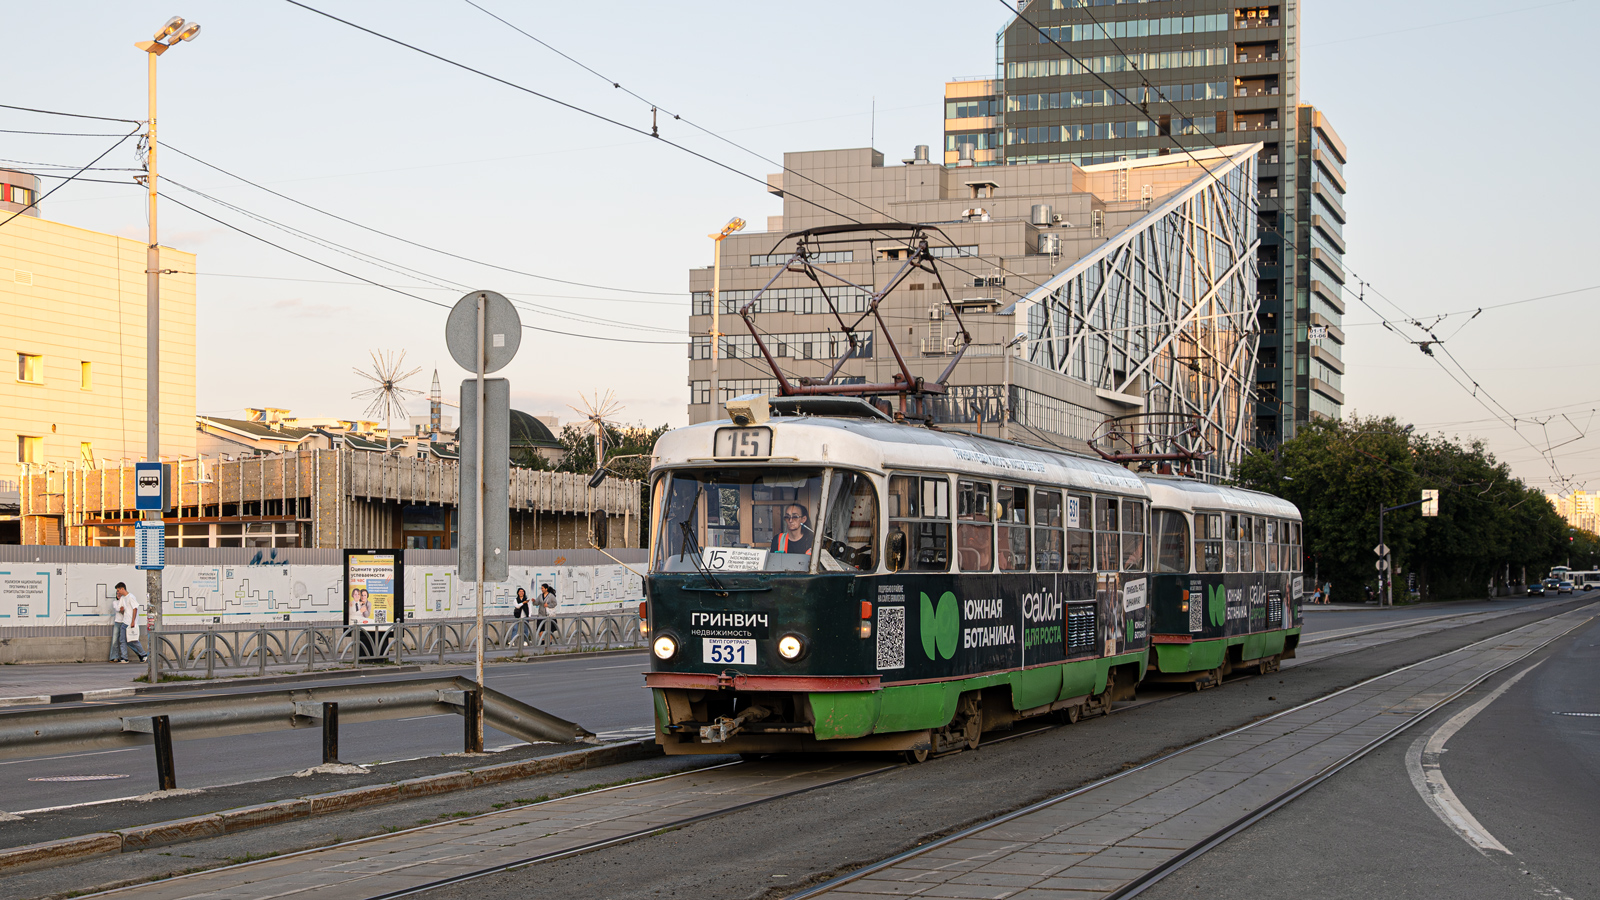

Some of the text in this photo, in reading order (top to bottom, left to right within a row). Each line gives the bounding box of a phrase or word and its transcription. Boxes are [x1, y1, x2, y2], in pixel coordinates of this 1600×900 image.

[728, 432, 759, 456] 15
[1070, 500, 1078, 517] 531
[708, 550, 728, 569] 15
[964, 599, 1003, 620] ЮЖНАЯ
[1022, 587, 1062, 622] район
[691, 612, 768, 627] ГРИНВИЧ
[964, 625, 1015, 648] БОТАНИКА
[1025, 625, 1062, 650] ДЛЯ РОСТА
[711, 645, 745, 663] 531
